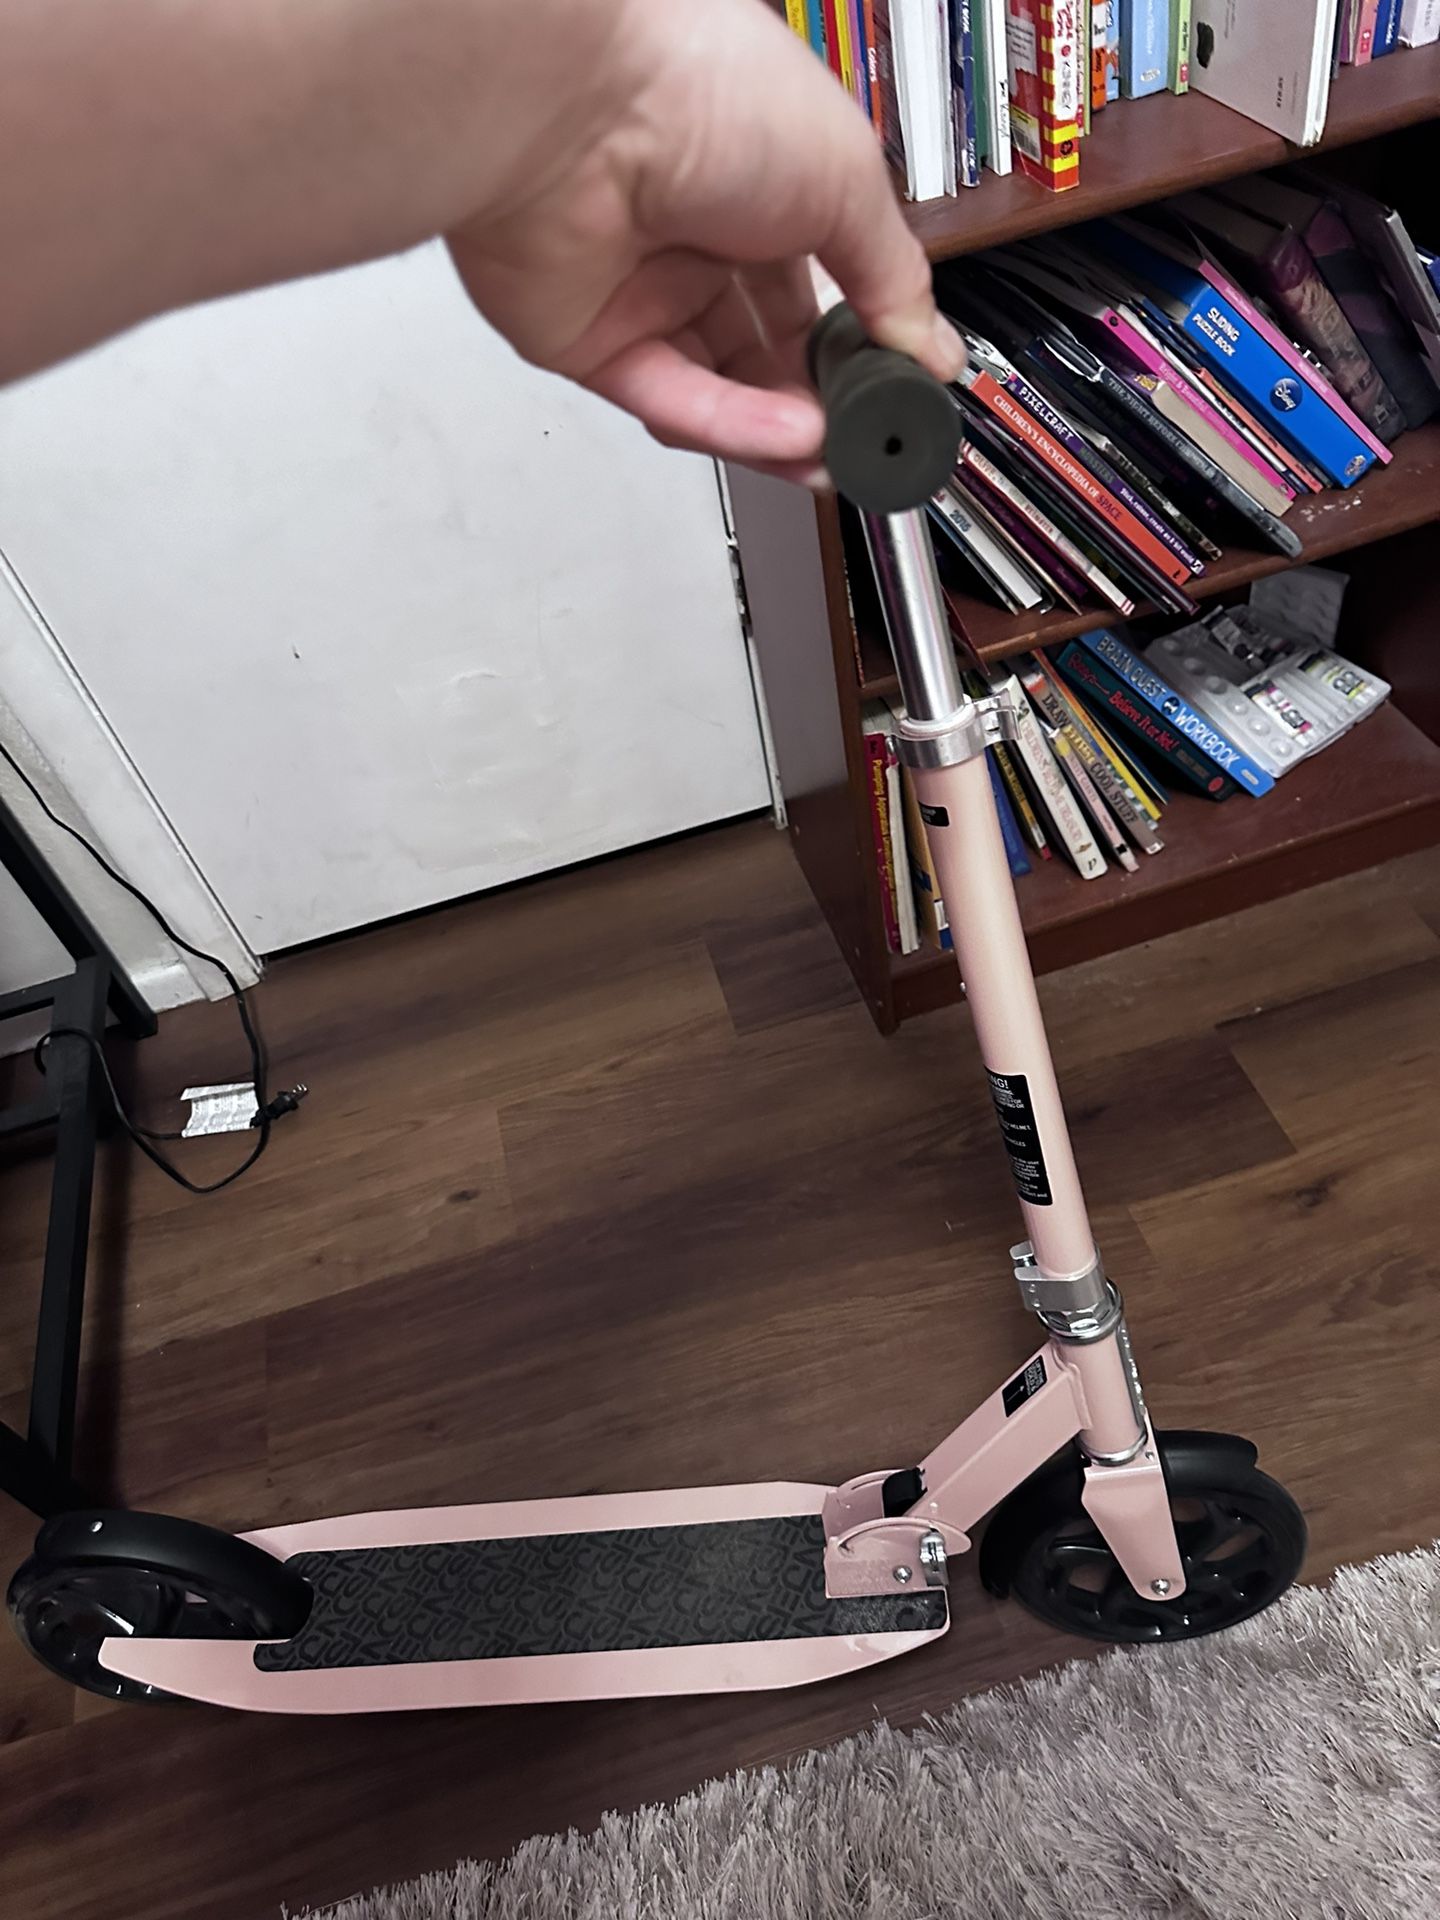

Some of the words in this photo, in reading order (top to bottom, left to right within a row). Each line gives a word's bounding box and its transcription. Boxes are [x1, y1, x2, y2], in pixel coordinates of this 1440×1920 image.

[1190, 312, 1219, 341] PUZZLE
[1213, 334, 1236, 358] BOOK
[1205, 305, 1242, 342] SLIDING
[1104, 376, 1127, 398] THE
[1271, 381, 1300, 412] Disney
[1016, 384, 1075, 443] PIXELCRAFT
[990, 392, 1040, 442] CHILDREN'S
[1034, 435, 1092, 491] ENCYCLOPEDIA
[1085, 484, 1101, 500] OF
[1094, 493, 1123, 522] SPACE
[948, 507, 972, 533] 2015
[1093, 634, 1136, 676] BRAIN
[1127, 665, 1167, 704] QUEST
[1171, 706, 1241, 771] WORKBOOK
[1105, 688, 1145, 725] Believe
[1152, 727, 1181, 755] Not!
[870, 758, 885, 795] Pumping
[1039, 691, 1072, 730] DRAW
[1087, 759, 1117, 794] COOL
[1107, 788, 1140, 826] STUFF
